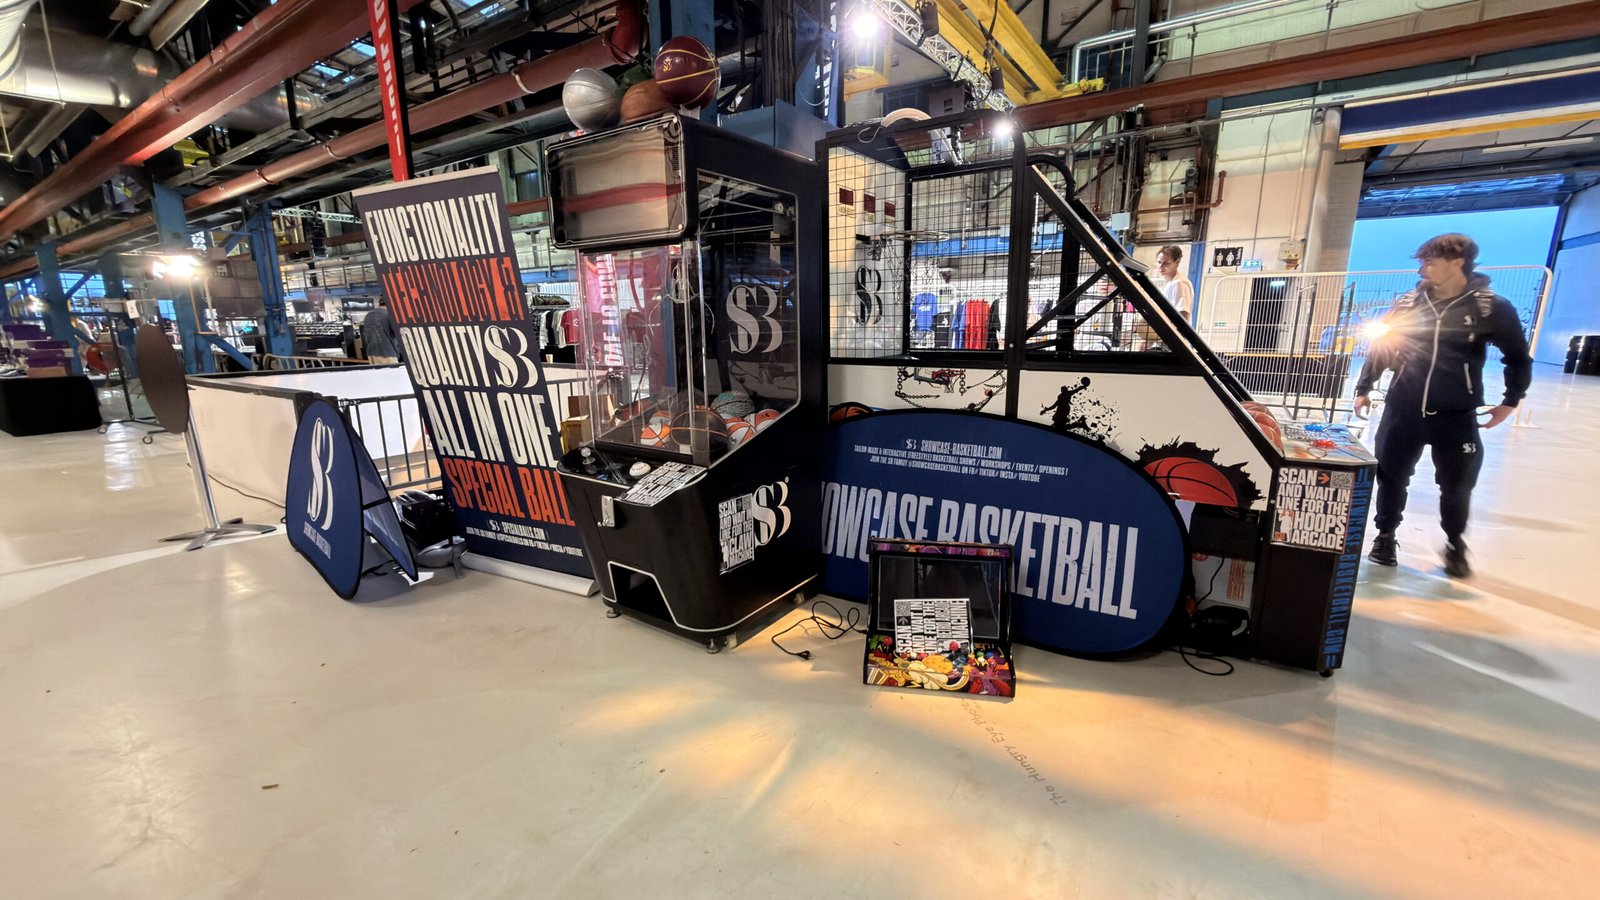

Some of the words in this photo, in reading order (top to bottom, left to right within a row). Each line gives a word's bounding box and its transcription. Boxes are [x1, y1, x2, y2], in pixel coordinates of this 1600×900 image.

[364, 192, 506, 264] FUNCTIONALITY
[383, 257, 500, 324] TECHNOLOGY
[400, 326, 491, 388] QUALITY
[422, 390, 476, 458] ALL
[464, 390, 505, 462] IN
[496, 392, 558, 468] ONE
[920, 440, 1002, 459] SHOWCASE-BASKETBALL.COM
[932, 454, 958, 464] BASKETBALL
[959, 456, 976, 466] SHOWS
[981, 459, 1011, 470] WORKSHOPS
[1016, 463, 1034, 472] EVENTS
[1039, 465, 1065, 475] OPENINGS
[1019, 472, 1040, 482] YOUTUBE
[1278, 468, 1318, 486] SCAN
[442, 458, 525, 518] SPECIAL
[518, 467, 576, 526] BALL
[1278, 484, 1301, 498] AND
[1304, 486, 1335, 500] WAIT
[1337, 488, 1350, 502] IN
[719, 499, 737, 519] SCAN
[1276, 496, 1300, 511] LINE
[1302, 498, 1324, 514] FOR
[1327, 500, 1349, 516] THE
[720, 515, 732, 530] AND
[732, 523, 742, 537] FOR
[743, 520, 752, 533] THE
[1294, 512, 1346, 535] HOOPS
[730, 531, 752, 556] CLAW
[1291, 531, 1344, 550] ARCADE
[910, 601, 923, 610] IN
[923, 601, 935, 616] THE
[911, 611, 924, 633] WAIT
[923, 618, 936, 634] FOR
[950, 600, 969, 638] MACHINE
[897, 626, 912, 653] SCAN
[912, 635, 925, 653] AND
[924, 636, 937, 653] LINE
[986, 726, 1004, 743] Eye
[1005, 745, 1045, 783] Hungry
